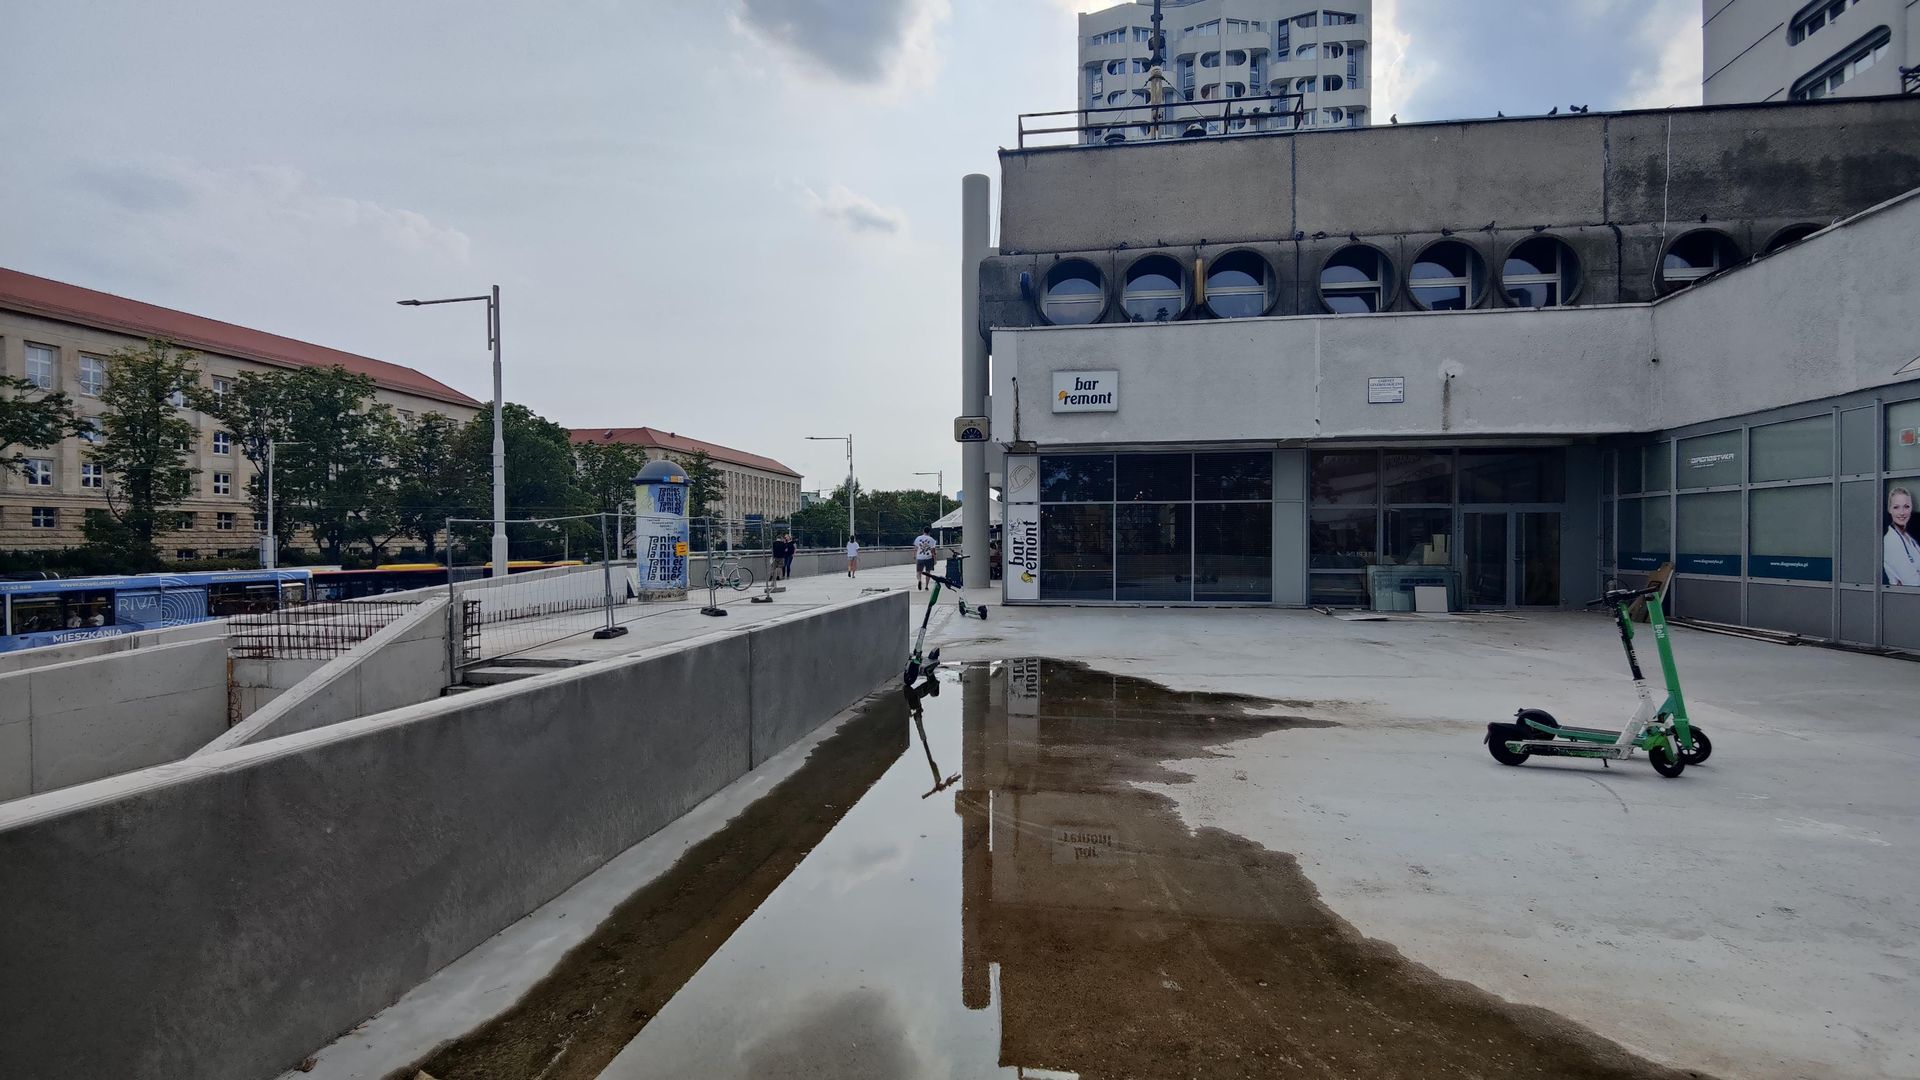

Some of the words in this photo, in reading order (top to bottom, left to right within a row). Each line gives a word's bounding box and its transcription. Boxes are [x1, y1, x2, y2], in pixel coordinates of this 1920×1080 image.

[1074, 376, 1099, 391] bar
[1063, 391, 1112, 405] remont
[1008, 537, 1024, 567] bar
[1023, 520, 1037, 578] remont
[118, 596, 160, 612] RIVA
[52, 628, 123, 643] MIESZKANIA
[1655, 624, 1665, 639] Bolt
